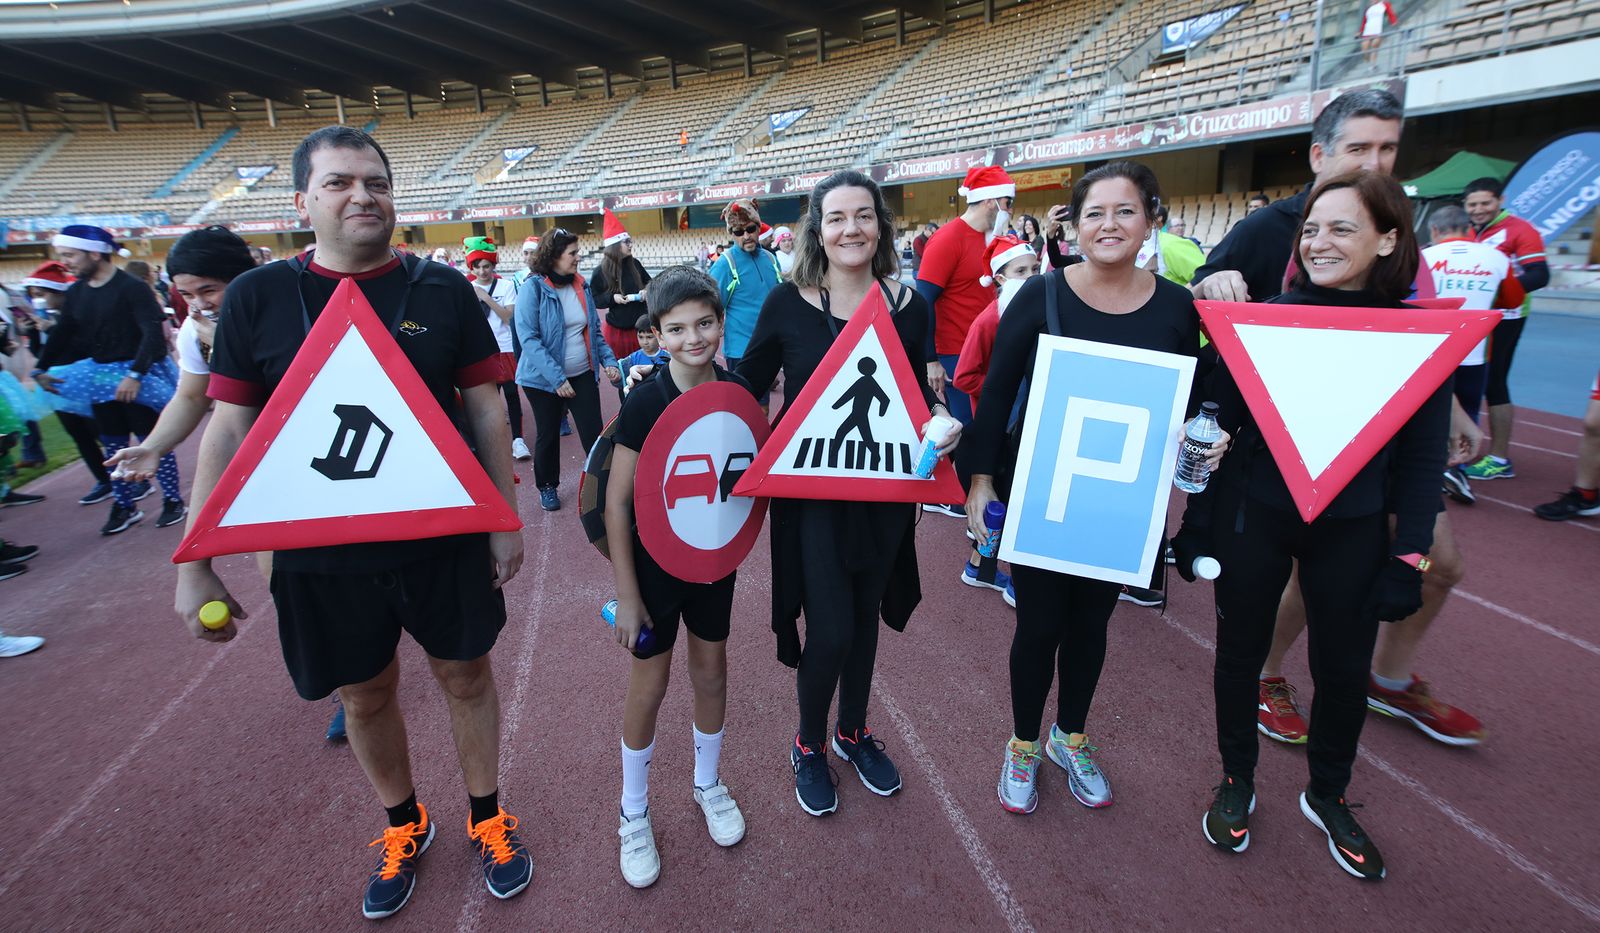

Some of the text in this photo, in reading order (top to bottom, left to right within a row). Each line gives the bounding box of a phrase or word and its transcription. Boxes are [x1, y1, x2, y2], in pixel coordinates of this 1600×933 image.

[1190, 104, 1292, 136] Cruzcampo
[1024, 136, 1095, 160] Cruzcampo
[900, 158, 952, 177] Cruzcampo
[795, 174, 829, 189] Cruzca
[704, 184, 743, 199] Cruzcampo
[546, 201, 580, 213] Cruzcampo
[623, 194, 658, 207] Cruzcampo
[1045, 396, 1151, 523] P
